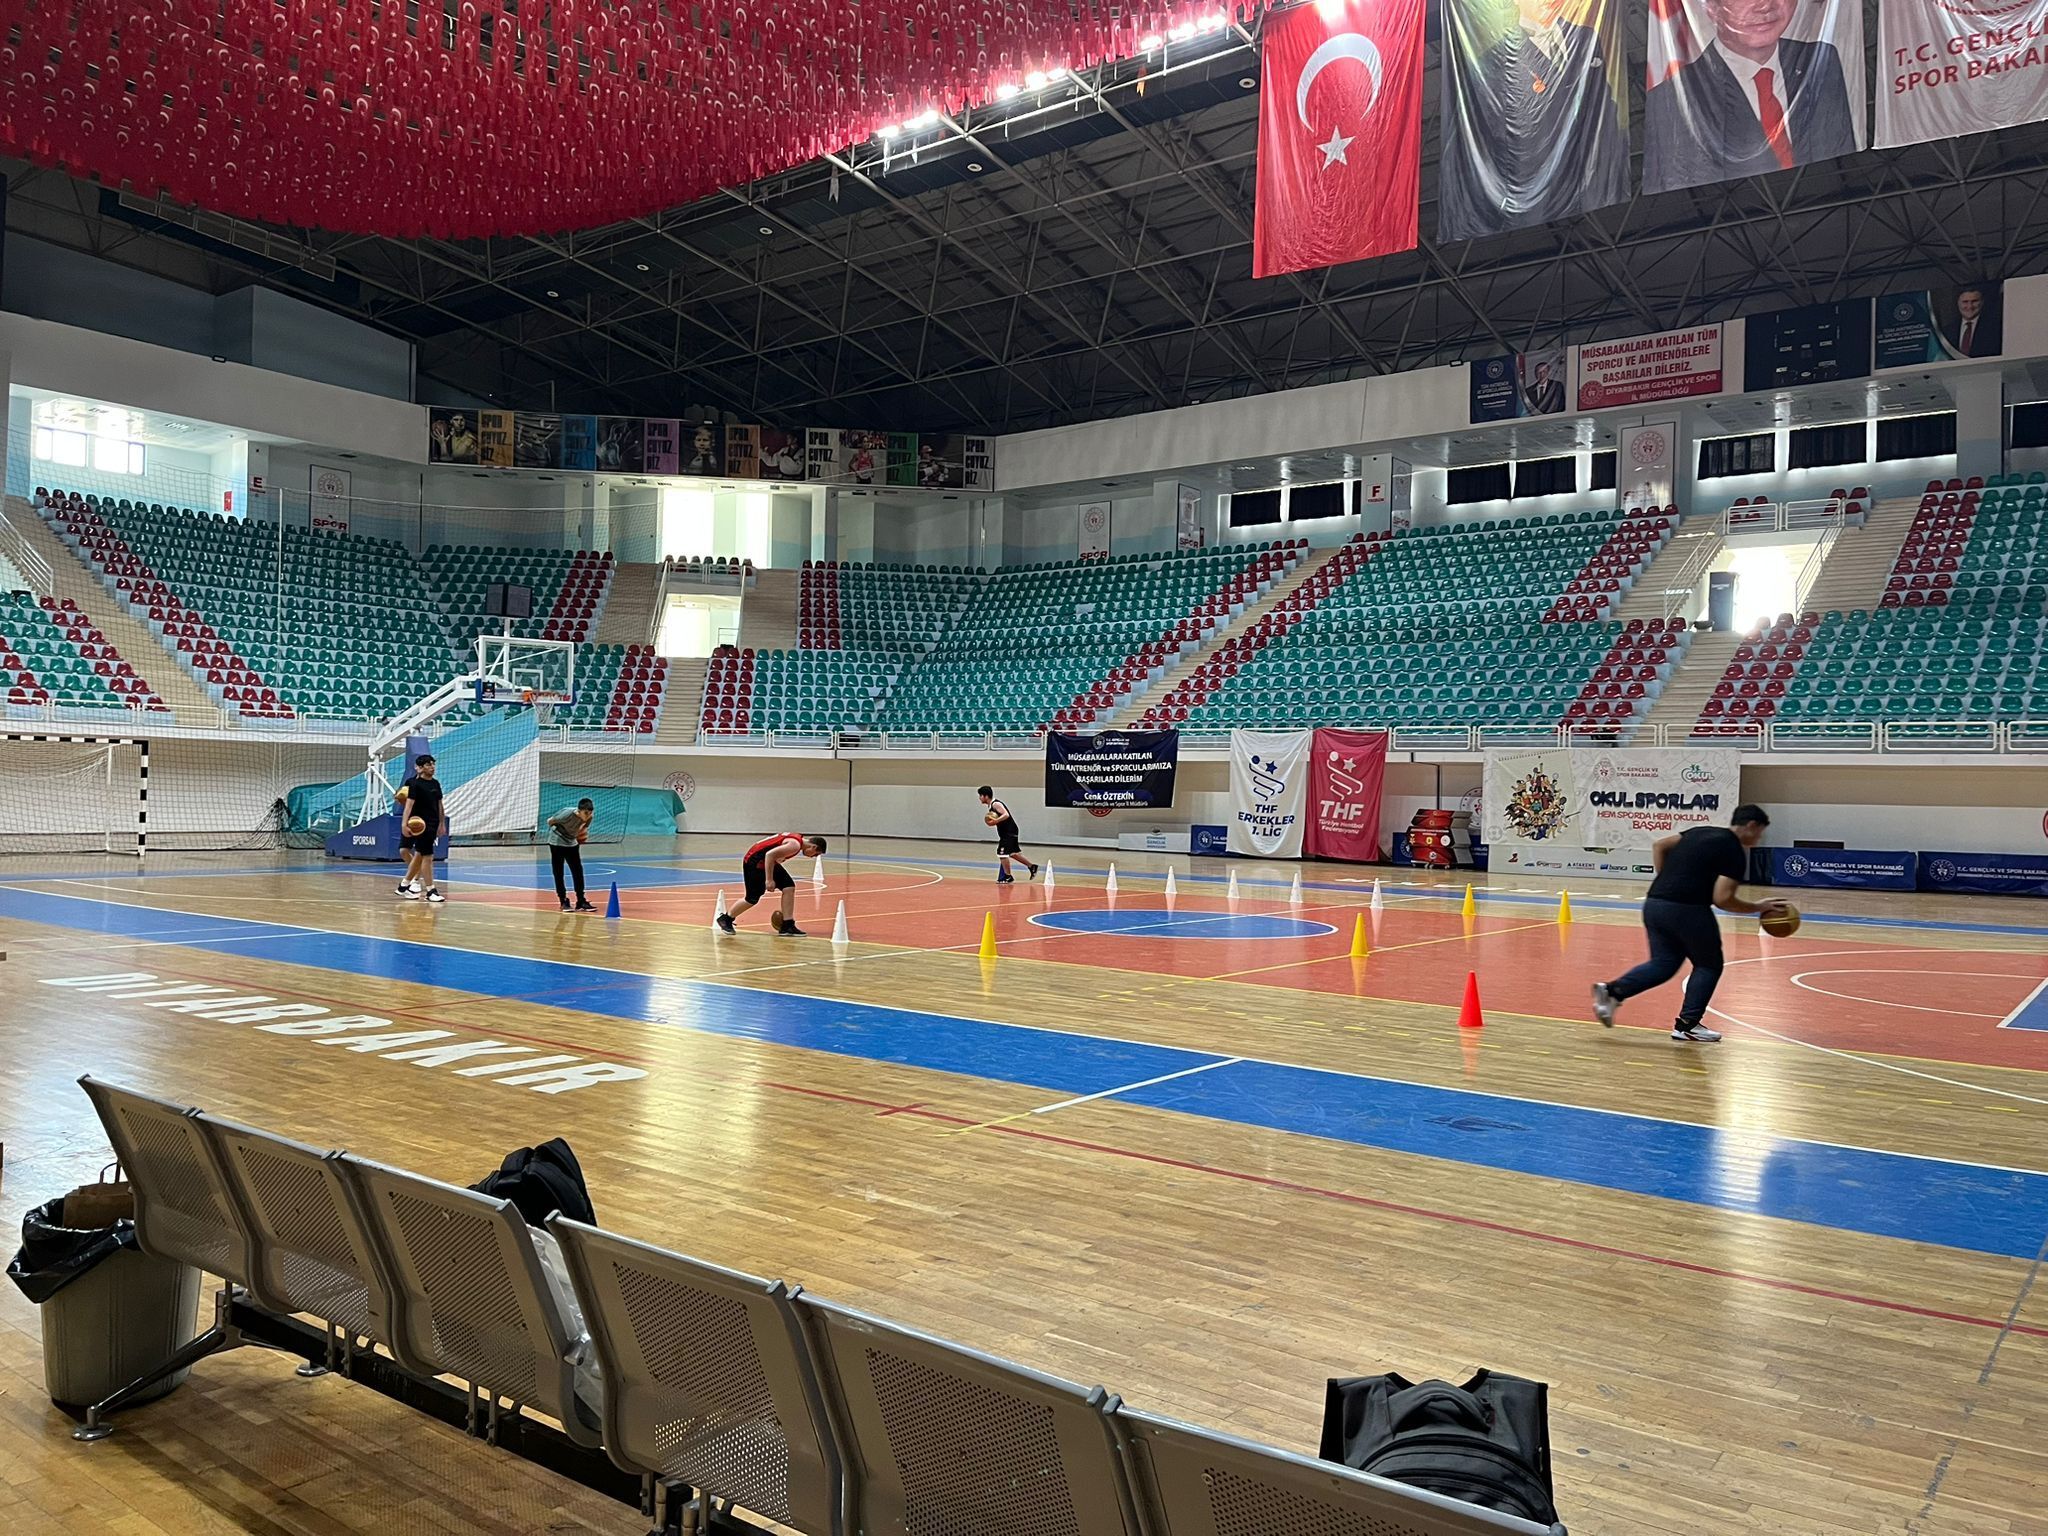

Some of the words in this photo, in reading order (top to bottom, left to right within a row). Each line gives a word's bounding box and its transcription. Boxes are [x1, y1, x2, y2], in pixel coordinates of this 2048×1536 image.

[1894, 43, 1938, 67] T.C.
[1894, 65, 1959, 95] SPOR
[1581, 339, 1654, 360] MÜSABAKALARA
[1655, 331, 1695, 348] KATILAN
[1697, 328, 1718, 341] TÜM
[1587, 358, 1623, 372] SPORCU
[1625, 355, 1637, 366] VE
[1638, 344, 1711, 365] ANTRENÖRLERE
[1602, 366, 1652, 384] BAŞARILAR
[1654, 361, 1693, 376] DİLERİZ.
[1651, 379, 1684, 389] GENÇLİK
[1695, 373, 1717, 383] SPOR
[253, 476, 263, 488] E
[1371, 485, 1381, 497] F
[313, 518, 348, 530] SPOR
[1080, 550, 1108, 560] SPOR
[1076, 775, 1114, 785] BAŞARILAR
[1114, 774, 1143, 783] DİLERİM
[1590, 791, 1634, 808] OKUL
[1635, 792, 1719, 811] SPORLARI
[1254, 803, 1278, 814] THF
[1320, 800, 1365, 821] THF
[1237, 811, 1295, 826] ERKEKLER
[1597, 810, 1616, 819] HEM
[1616, 811, 1651, 820] SPORDA
[1653, 812, 1672, 821] HEM
[1673, 813, 1709, 821] OKULDA
[1251, 826, 1260, 836] 1.
[1262, 825, 1282, 837] LİG
[1632, 820, 1672, 832] BAŞARI
[352, 836, 376, 845] SPORSAN
[37, 972, 651, 1096] DİYARBAKIR
